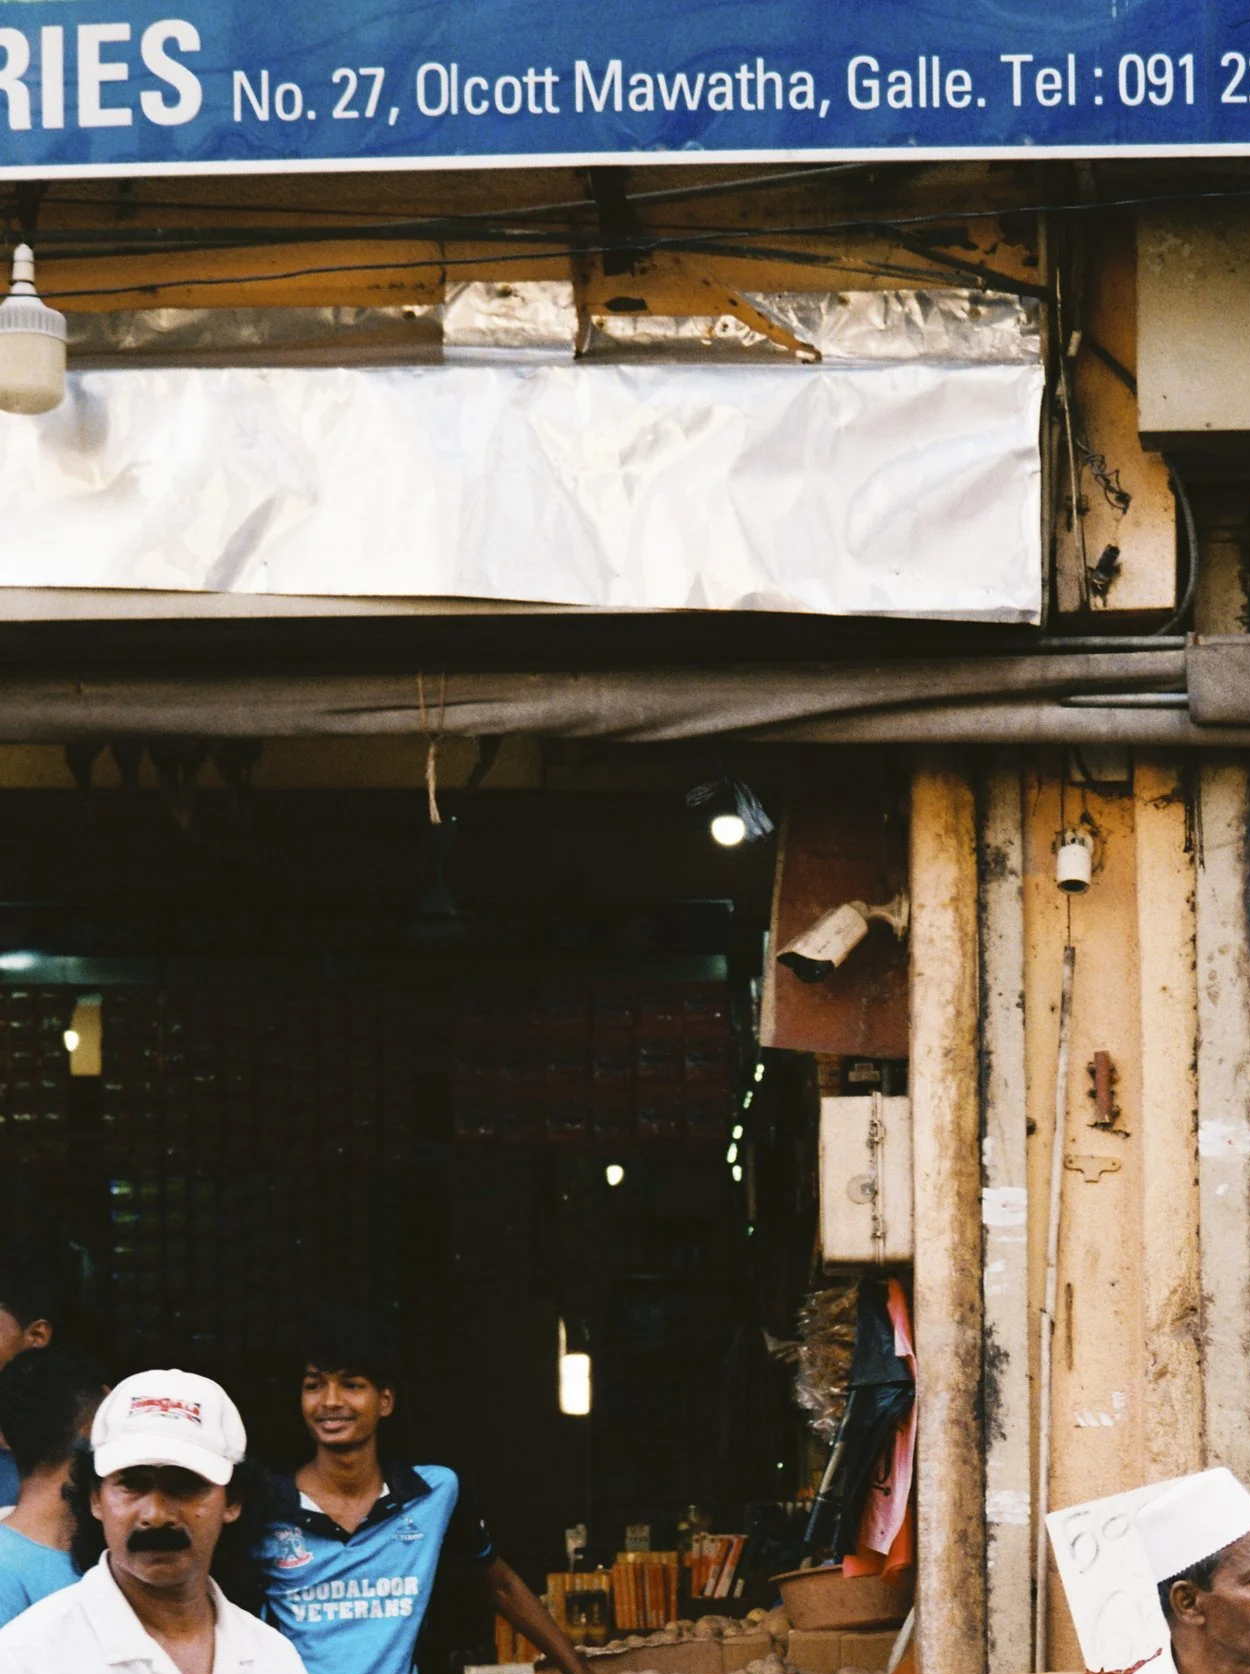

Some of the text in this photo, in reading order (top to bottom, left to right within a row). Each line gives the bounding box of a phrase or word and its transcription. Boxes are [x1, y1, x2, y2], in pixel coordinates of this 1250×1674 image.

[0, 19, 203, 131] RIES
[233, 69, 316, 122] No.
[332, 66, 399, 126] 27,
[416, 59, 560, 117] Olcott
[575, 57, 830, 118] Mawatha,
[847, 55, 986, 110] Galle.
[1000, 53, 1076, 107] Tel
[1118, 53, 1194, 106] 091
[292, 1598, 413, 1623] VETERANS
